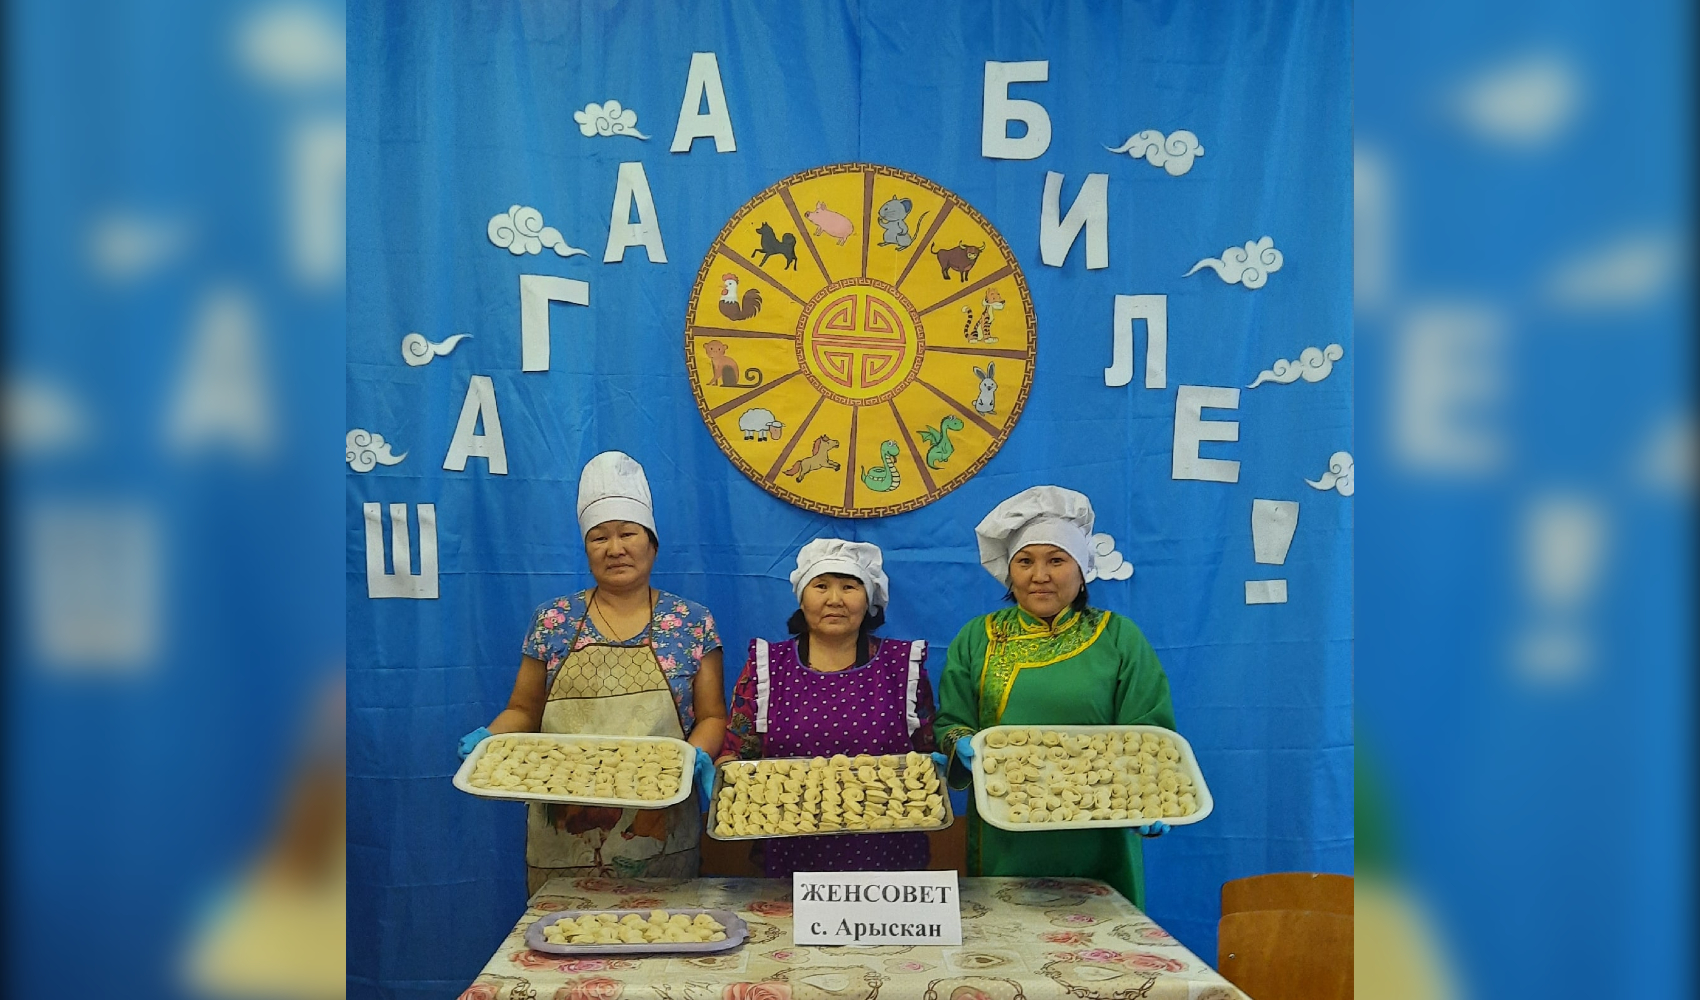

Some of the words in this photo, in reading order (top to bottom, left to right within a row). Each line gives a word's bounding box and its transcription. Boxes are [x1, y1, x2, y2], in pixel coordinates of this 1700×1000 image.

[364, 52, 737, 599] ШАГАА
[981, 60, 1299, 604] БИЛЕ!
[800, 883, 952, 904] ЖЕНСОВЕТ
[811, 921, 827, 936] с.
[835, 918, 941, 942] Арыскан
